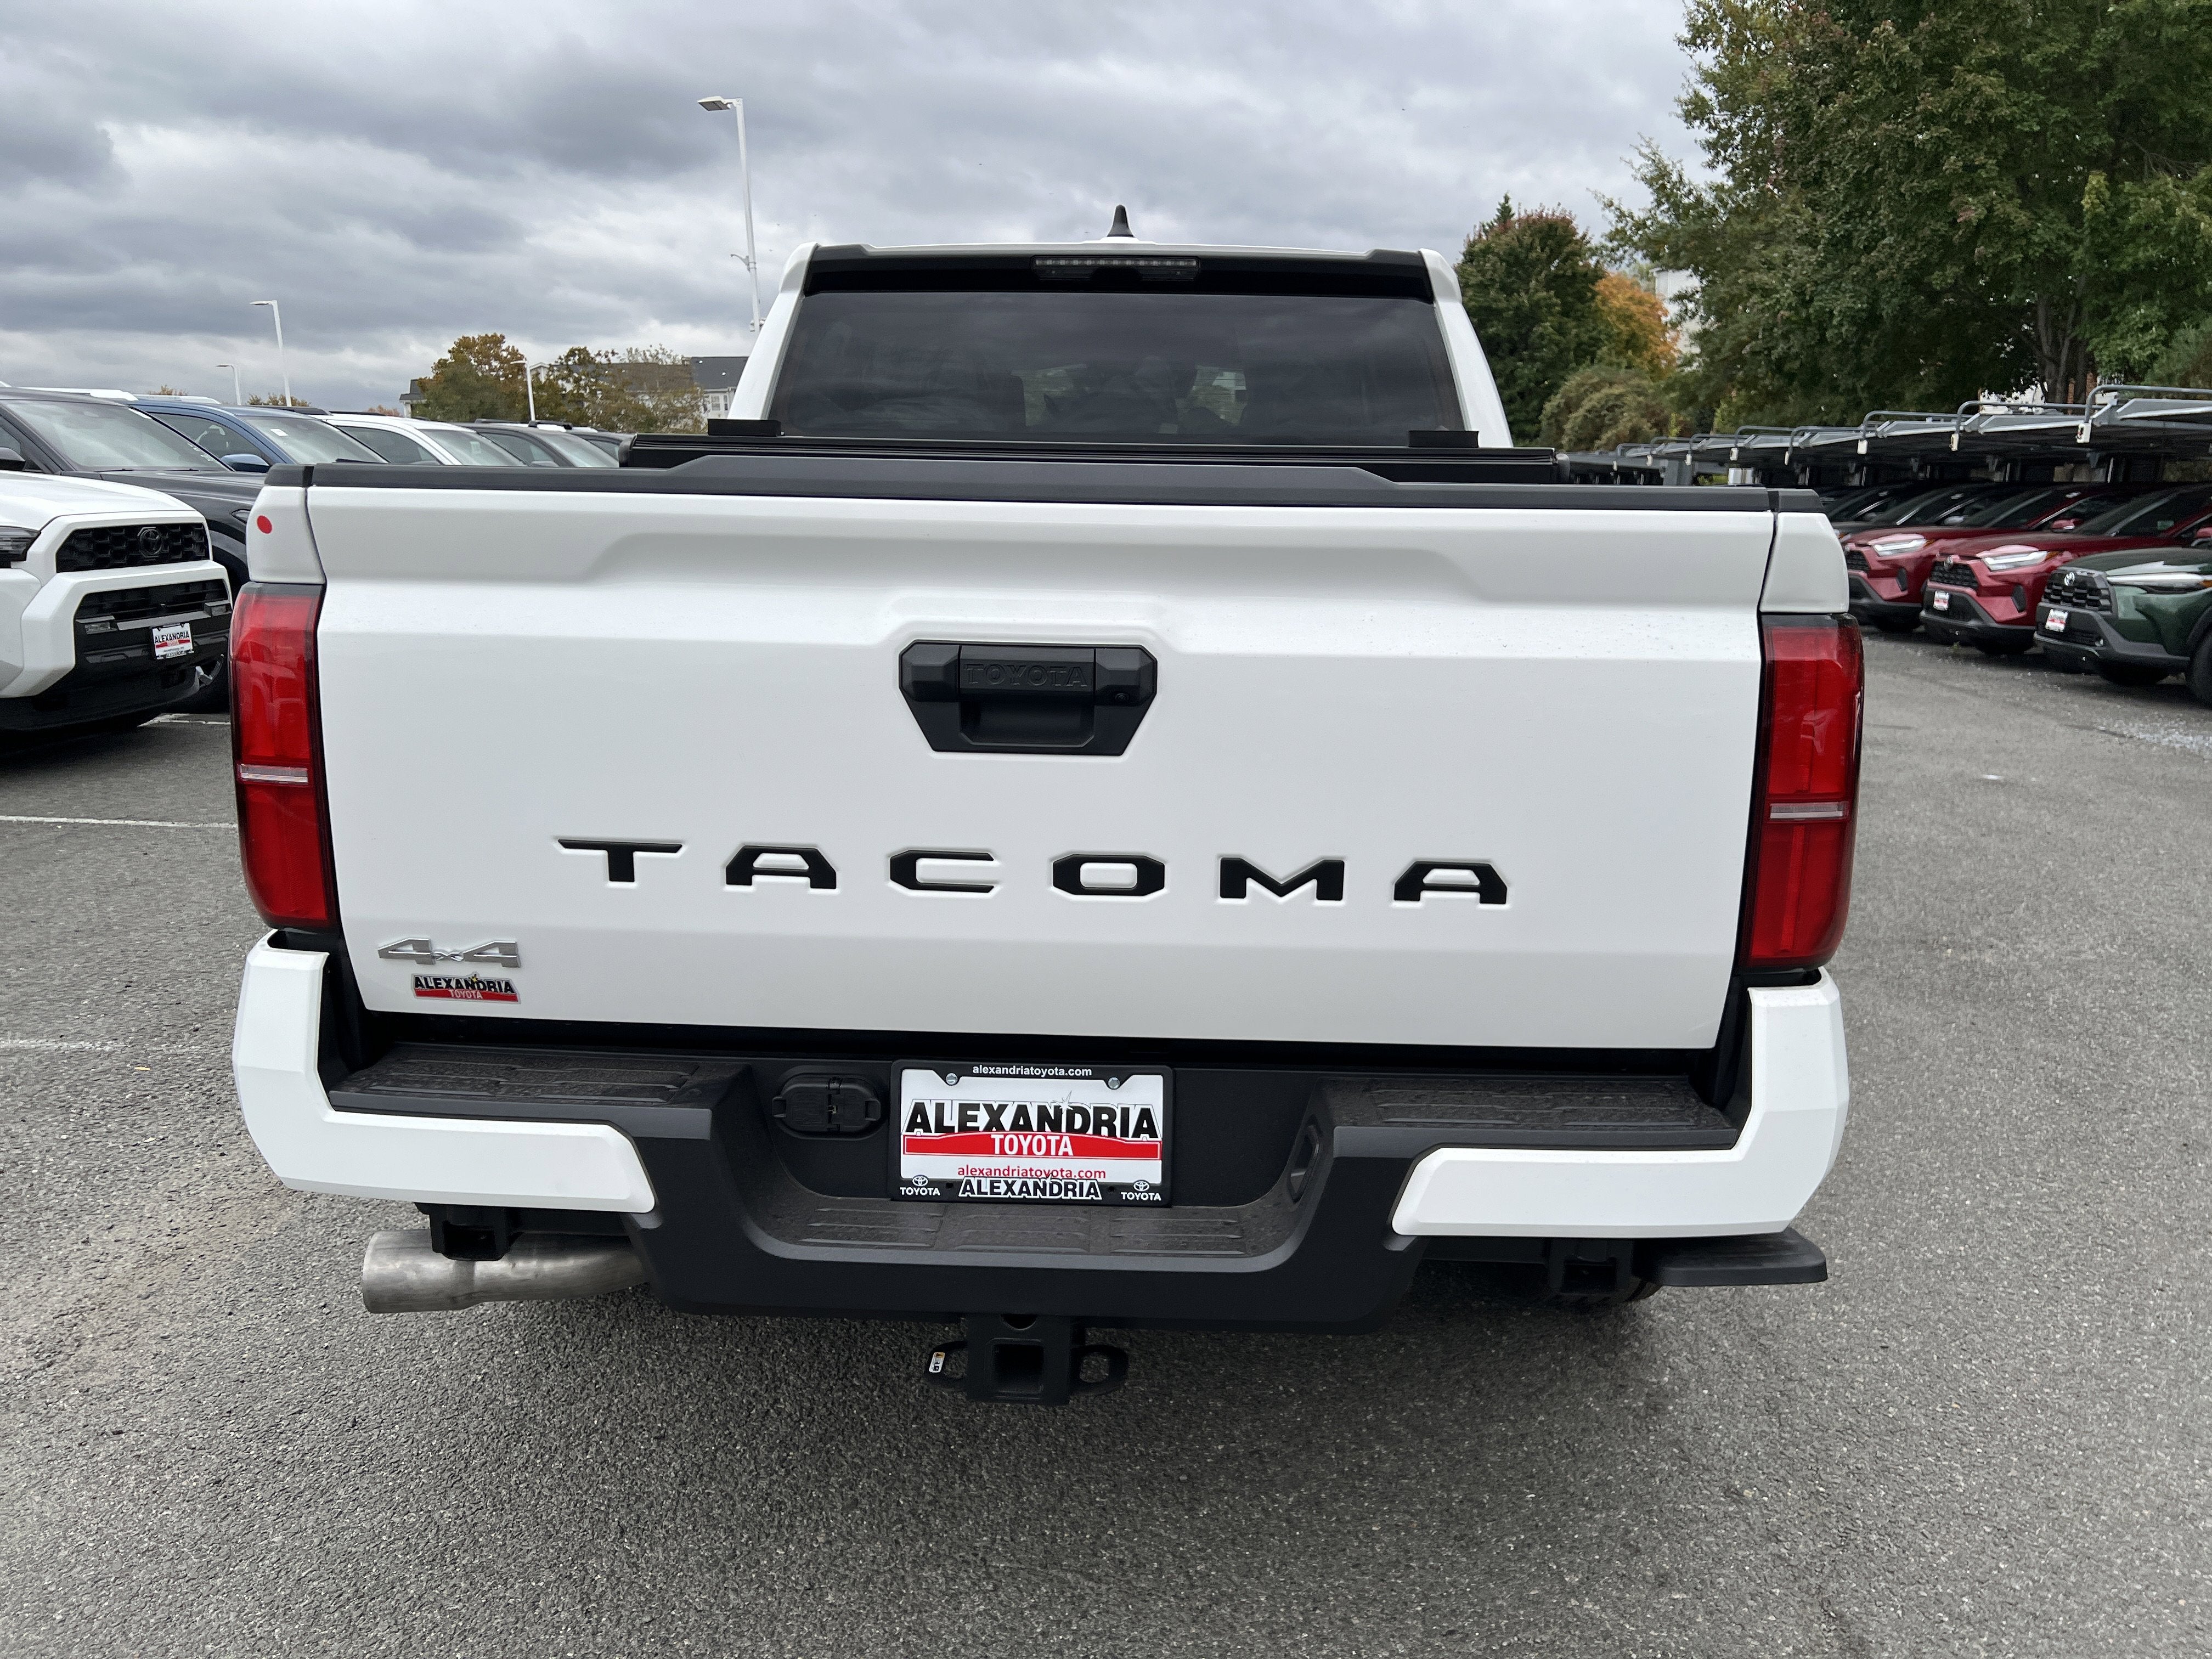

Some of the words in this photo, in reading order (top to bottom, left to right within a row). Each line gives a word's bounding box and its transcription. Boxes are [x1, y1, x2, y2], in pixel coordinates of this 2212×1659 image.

[964, 663, 1088, 688] TOYOTA
[557, 839, 1508, 905] TACOMA
[414, 975, 516, 994] ALEXANDRIA
[448, 989, 483, 999] TOYOTA
[972, 1064, 1092, 1077] alexandriatoyota.com
[904, 1101, 1161, 1139] ALEXANDRIA
[990, 1133, 1074, 1156] TOYOTA
[957, 1164, 1107, 1180] alexandriatoyota.com
[899, 1186, 941, 1197] TOYOTA
[958, 1176, 1102, 1200] ALEXANDRIA
[1120, 1191, 1161, 1201] TOYOTA
